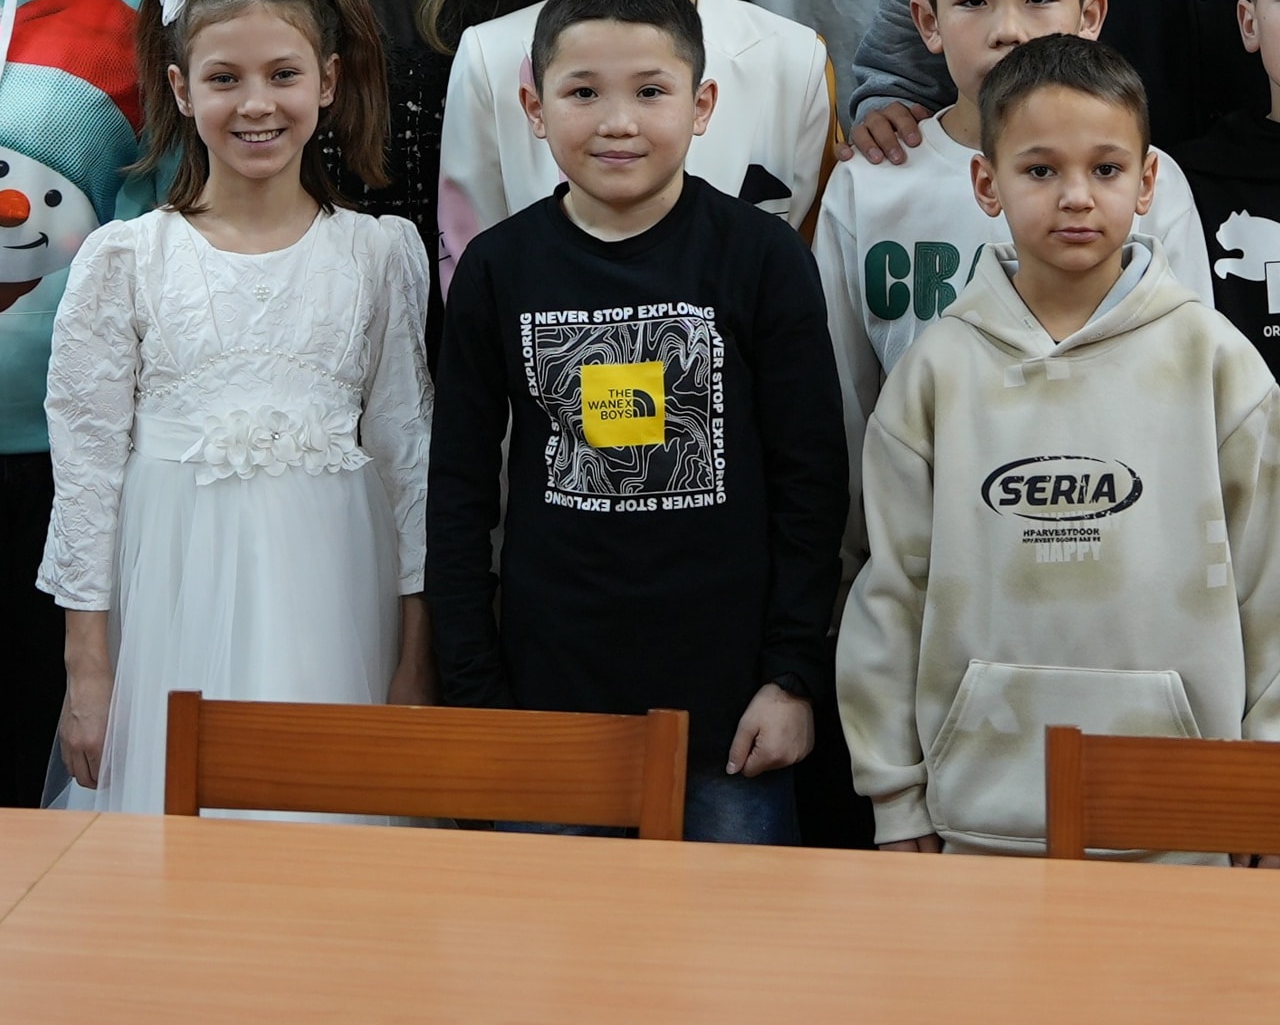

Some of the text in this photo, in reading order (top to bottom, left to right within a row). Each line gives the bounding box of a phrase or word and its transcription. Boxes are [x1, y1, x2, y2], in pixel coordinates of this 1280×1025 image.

[864, 240, 987, 321] CR
[535, 310, 589, 325] NEVER
[592, 307, 634, 322] STOP
[608, 389, 633, 398] THE
[711, 372, 724, 414] STOP
[588, 399, 634, 410] WANEX
[600, 409, 634, 420] BOYS
[544, 435, 560, 488] NVER
[999, 473, 1118, 506] SERIA
[615, 498, 658, 512] STOP
[662, 493, 714, 511] NEVER
[1035, 541, 1101, 563] HAPPY
